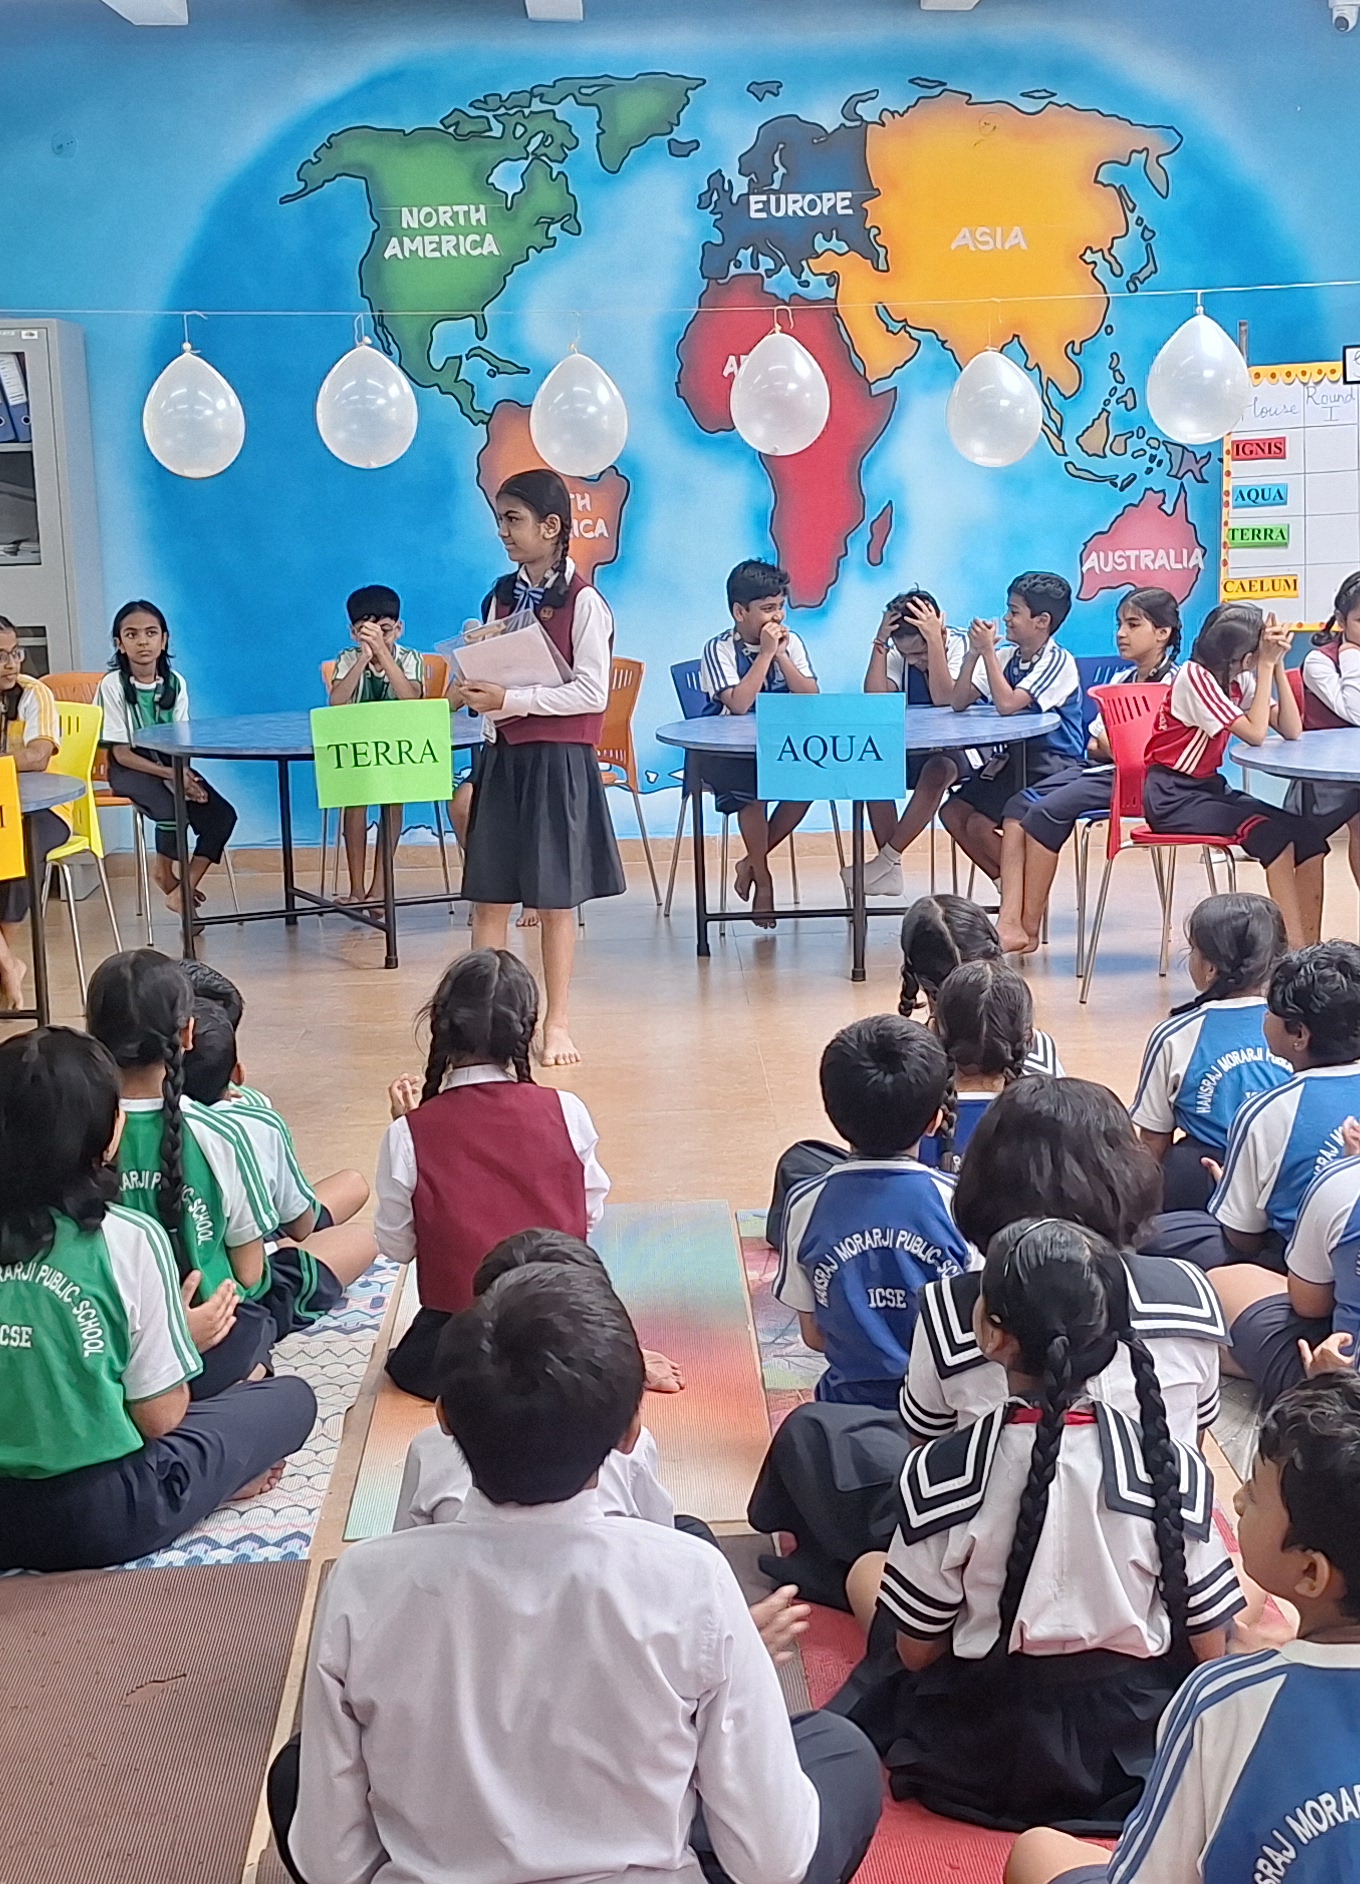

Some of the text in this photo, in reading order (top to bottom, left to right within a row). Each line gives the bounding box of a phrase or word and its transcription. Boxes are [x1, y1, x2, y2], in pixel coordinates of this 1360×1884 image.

[400, 204, 487, 229] NORTH
[748, 191, 854, 218] EUROPE
[383, 235, 501, 259] AMERICA
[950, 226, 1028, 251] ASIA
[1306, 385, 1356, 406] Round
[1234, 440, 1284, 457] IGNIS
[1234, 487, 1285, 504] AQUA
[1228, 527, 1287, 541] TERRA
[1082, 546, 1207, 573] AUSTRALIA
[1223, 578, 1298, 594] CAELUM
[326, 738, 440, 770] TERRA
[776, 734, 885, 770] AQUA
[1196, 1065, 1223, 1114] HANSRAJ
[1217, 1047, 1264, 1073] MORARJI
[1314, 1141, 1339, 1178] SRAJ
[119, 1170, 149, 1192] ARJI
[188, 1198, 214, 1246] SCHOOL
[813, 1228, 942, 1309] HANSRAJ MORARJI PUBLIC
[867, 1287, 907, 1309] ICSE
[35, 1264, 81, 1303] PUBLIC
[72, 1299, 105, 1359] SCHOOL
[1252, 1829, 1299, 1884] SRAJ
